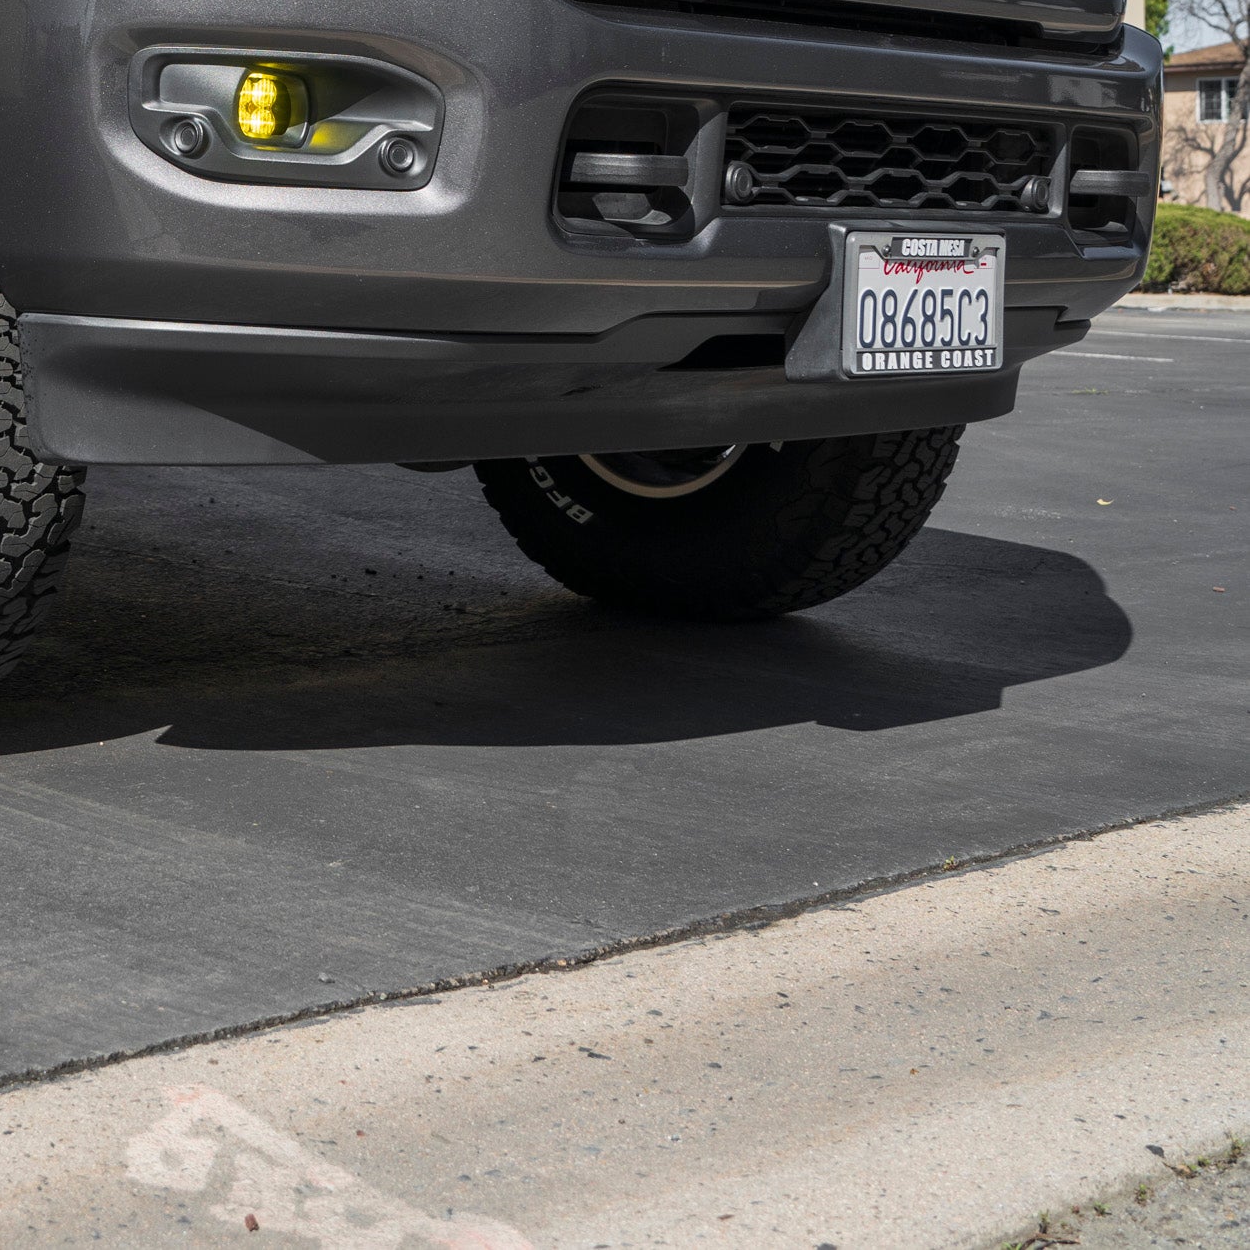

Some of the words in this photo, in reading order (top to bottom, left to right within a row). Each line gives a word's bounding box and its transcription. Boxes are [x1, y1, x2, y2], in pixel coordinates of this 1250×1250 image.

[901, 238, 938, 257] COSTA
[938, 239, 965, 257] MESA
[859, 288, 989, 348] 08685C3
[862, 352, 934, 371] ORANGE
[940, 349, 994, 368] COAST
